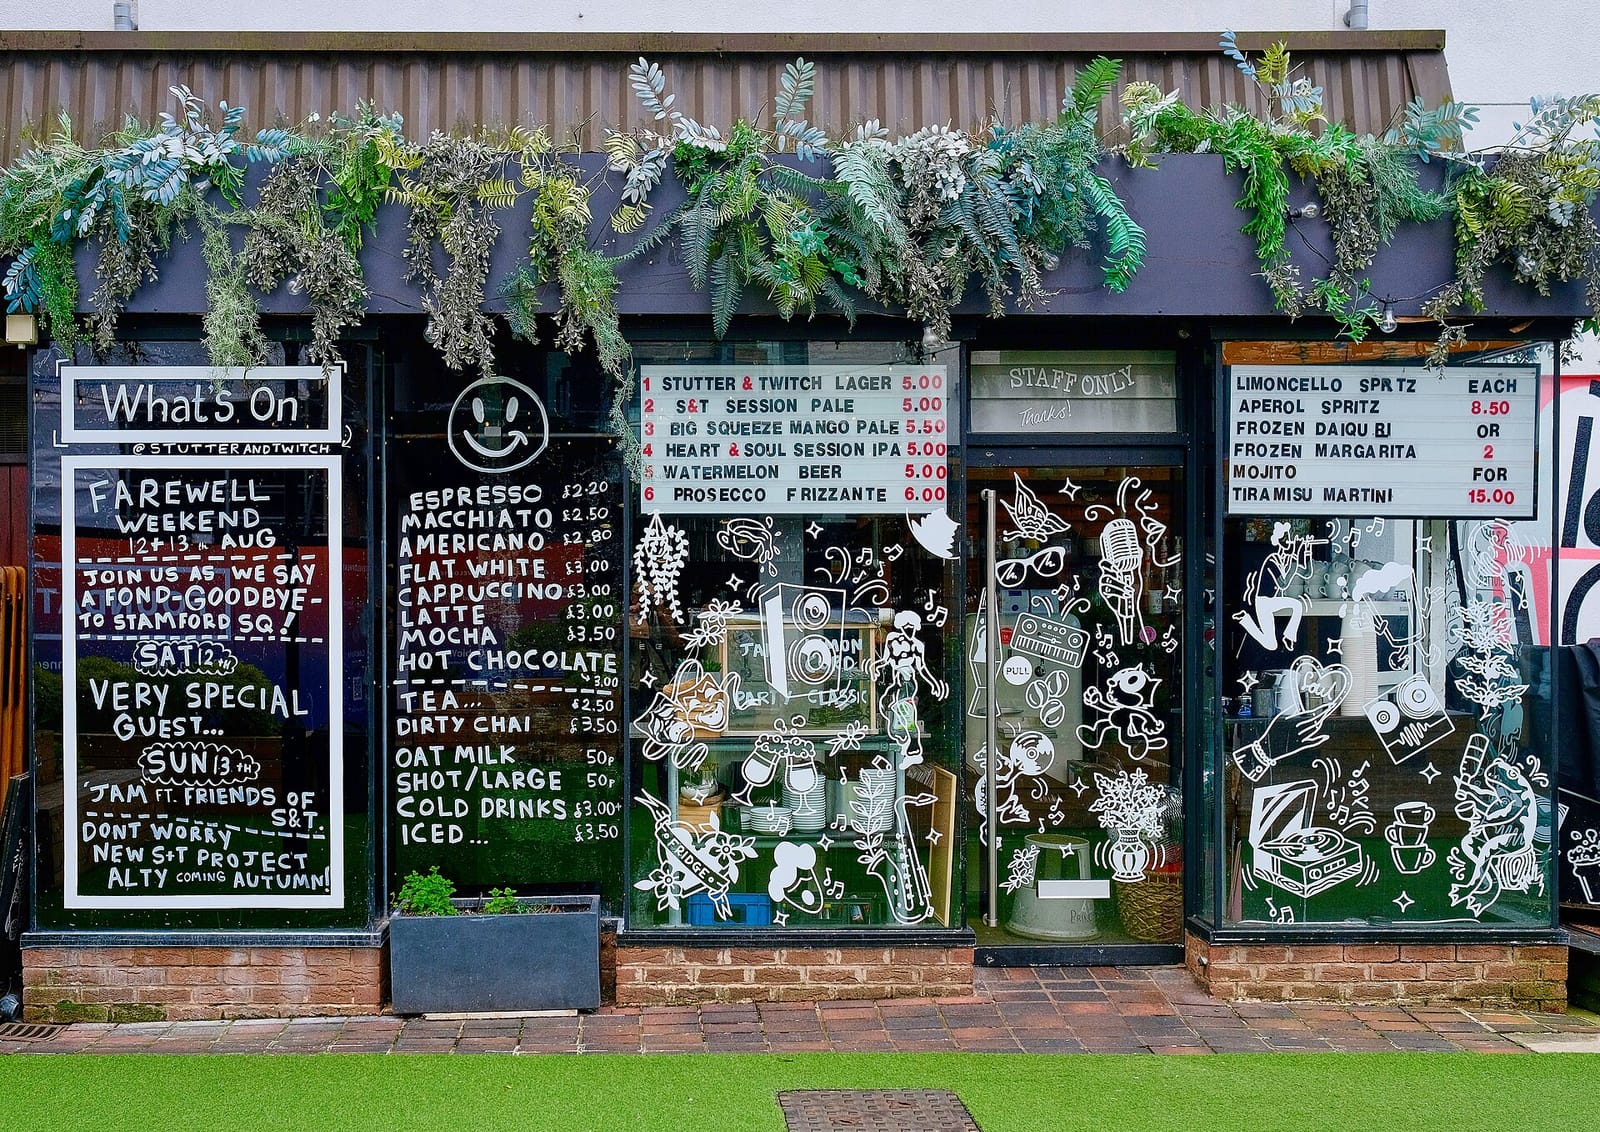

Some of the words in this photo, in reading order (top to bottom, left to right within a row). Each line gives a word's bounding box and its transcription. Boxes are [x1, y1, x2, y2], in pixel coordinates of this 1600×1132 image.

[642, 378, 650, 391] 1
[662, 377, 736, 391] STUTTER
[741, 376, 753, 391] &
[759, 376, 823, 391] TWITCH
[835, 376, 892, 391] LAGER
[902, 376, 942, 390] 5.00
[1010, 367, 1077, 393] STAFF
[1081, 365, 1135, 396] ONLY
[1237, 376, 1343, 392] LIMONCELLO
[1468, 378, 1517, 393] EACH
[101, 384, 234, 422] What's
[251, 386, 298, 422] On
[644, 400, 654, 413] 2
[676, 399, 709, 414] S&T
[726, 399, 798, 413] SESSION
[811, 398, 854, 413] PALE
[902, 397, 942, 412] 5.00
[1019, 400, 1072, 427] Thanks!
[1239, 399, 1305, 414] APEROL
[1321, 399, 1380, 415] SPRITZ
[1471, 401, 1510, 415] 8.50
[644, 423, 654, 436] 3
[670, 421, 697, 436] BIG
[707, 420, 782, 436] SQUEEZE
[789, 420, 850, 435] MANGO
[856, 420, 899, 435] PALE
[906, 419, 945, 434] 5.50
[1237, 421, 1305, 436] FROZEN
[1477, 424, 1501, 438] OR
[642, 443, 653, 457] 4
[666, 443, 720, 458] HEART
[729, 443, 739, 457] &
[744, 443, 787, 458] SOUL
[793, 443, 865, 458] SESSION
[872, 443, 901, 457] IPA
[907, 442, 946, 457] 5.00
[1233, 443, 1302, 459] FROZEN
[1315, 444, 1417, 459] MARGARITA
[1483, 445, 1494, 459] 2
[663, 465, 779, 480] WATERMELON
[799, 464, 842, 479] BEER
[904, 464, 947, 480] 5.00
[1233, 465, 1297, 480] MOJITO
[1473, 467, 1508, 481] FOR
[89, 479, 270, 513] FAREWELL
[410, 485, 542, 511] ESPRESSO
[644, 487, 654, 501] 6
[673, 487, 766, 502] PROSECCO
[904, 486, 946, 502] 6.00
[1232, 487, 1312, 502] TIRAMISU
[1323, 488, 1393, 504] MARTINI
[1468, 489, 1515, 505] 15.00
[116, 508, 260, 534] WEEKEND
[402, 508, 553, 533] MACCHIATO
[562, 507, 609, 522] £2.50
[221, 529, 276, 550] AUG
[399, 531, 544, 558] AMERICANO
[563, 529, 612, 546] £2.80
[84, 568, 142, 587] JOIN
[151, 566, 179, 582] US
[189, 565, 215, 581] AS
[232, 564, 265, 581] WE
[273, 564, 315, 585] SAY
[399, 558, 456, 585] FLAT
[466, 558, 545, 579] WHITE
[566, 559, 609, 576] £3.00
[82, 590, 95, 607] A
[398, 582, 562, 607] CAPPUCCINO
[567, 584, 611, 599] £3.00
[79, 613, 105, 628] TO
[114, 612, 231, 631] STAMFORD
[401, 605, 485, 628] LATTE
[566, 604, 613, 620] £3.00
[400, 626, 498, 650] MOCHA
[567, 625, 616, 642] £3.50
[139, 645, 193, 667] SAT
[399, 650, 451, 672] HOT
[468, 649, 617, 674] CHOCOLATE
[594, 676, 618, 688] 3.00
[1006, 667, 1030, 675] PULL
[89, 679, 169, 716] VERY
[186, 683, 308, 718] SPECIAL
[397, 716, 465, 736] DIRTY
[474, 716, 530, 733] CHAI
[149, 750, 207, 775] SUN
[395, 745, 445, 768] OAT
[454, 745, 516, 765] MILK
[184, 786, 276, 806] FRIENDS
[287, 791, 315, 810] OF
[396, 796, 469, 819] COLD
[481, 798, 567, 820] DRINKS
[82, 821, 141, 842] DONT
[151, 822, 231, 850] WORRY
[93, 842, 144, 863] NEW
[197, 849, 308, 872] PROJECT
[669, 838, 708, 881] FRIDGE
[108, 867, 168, 889] ALTY
[176, 871, 226, 884] COMING
[233, 866, 330, 893] AUTUMN!
